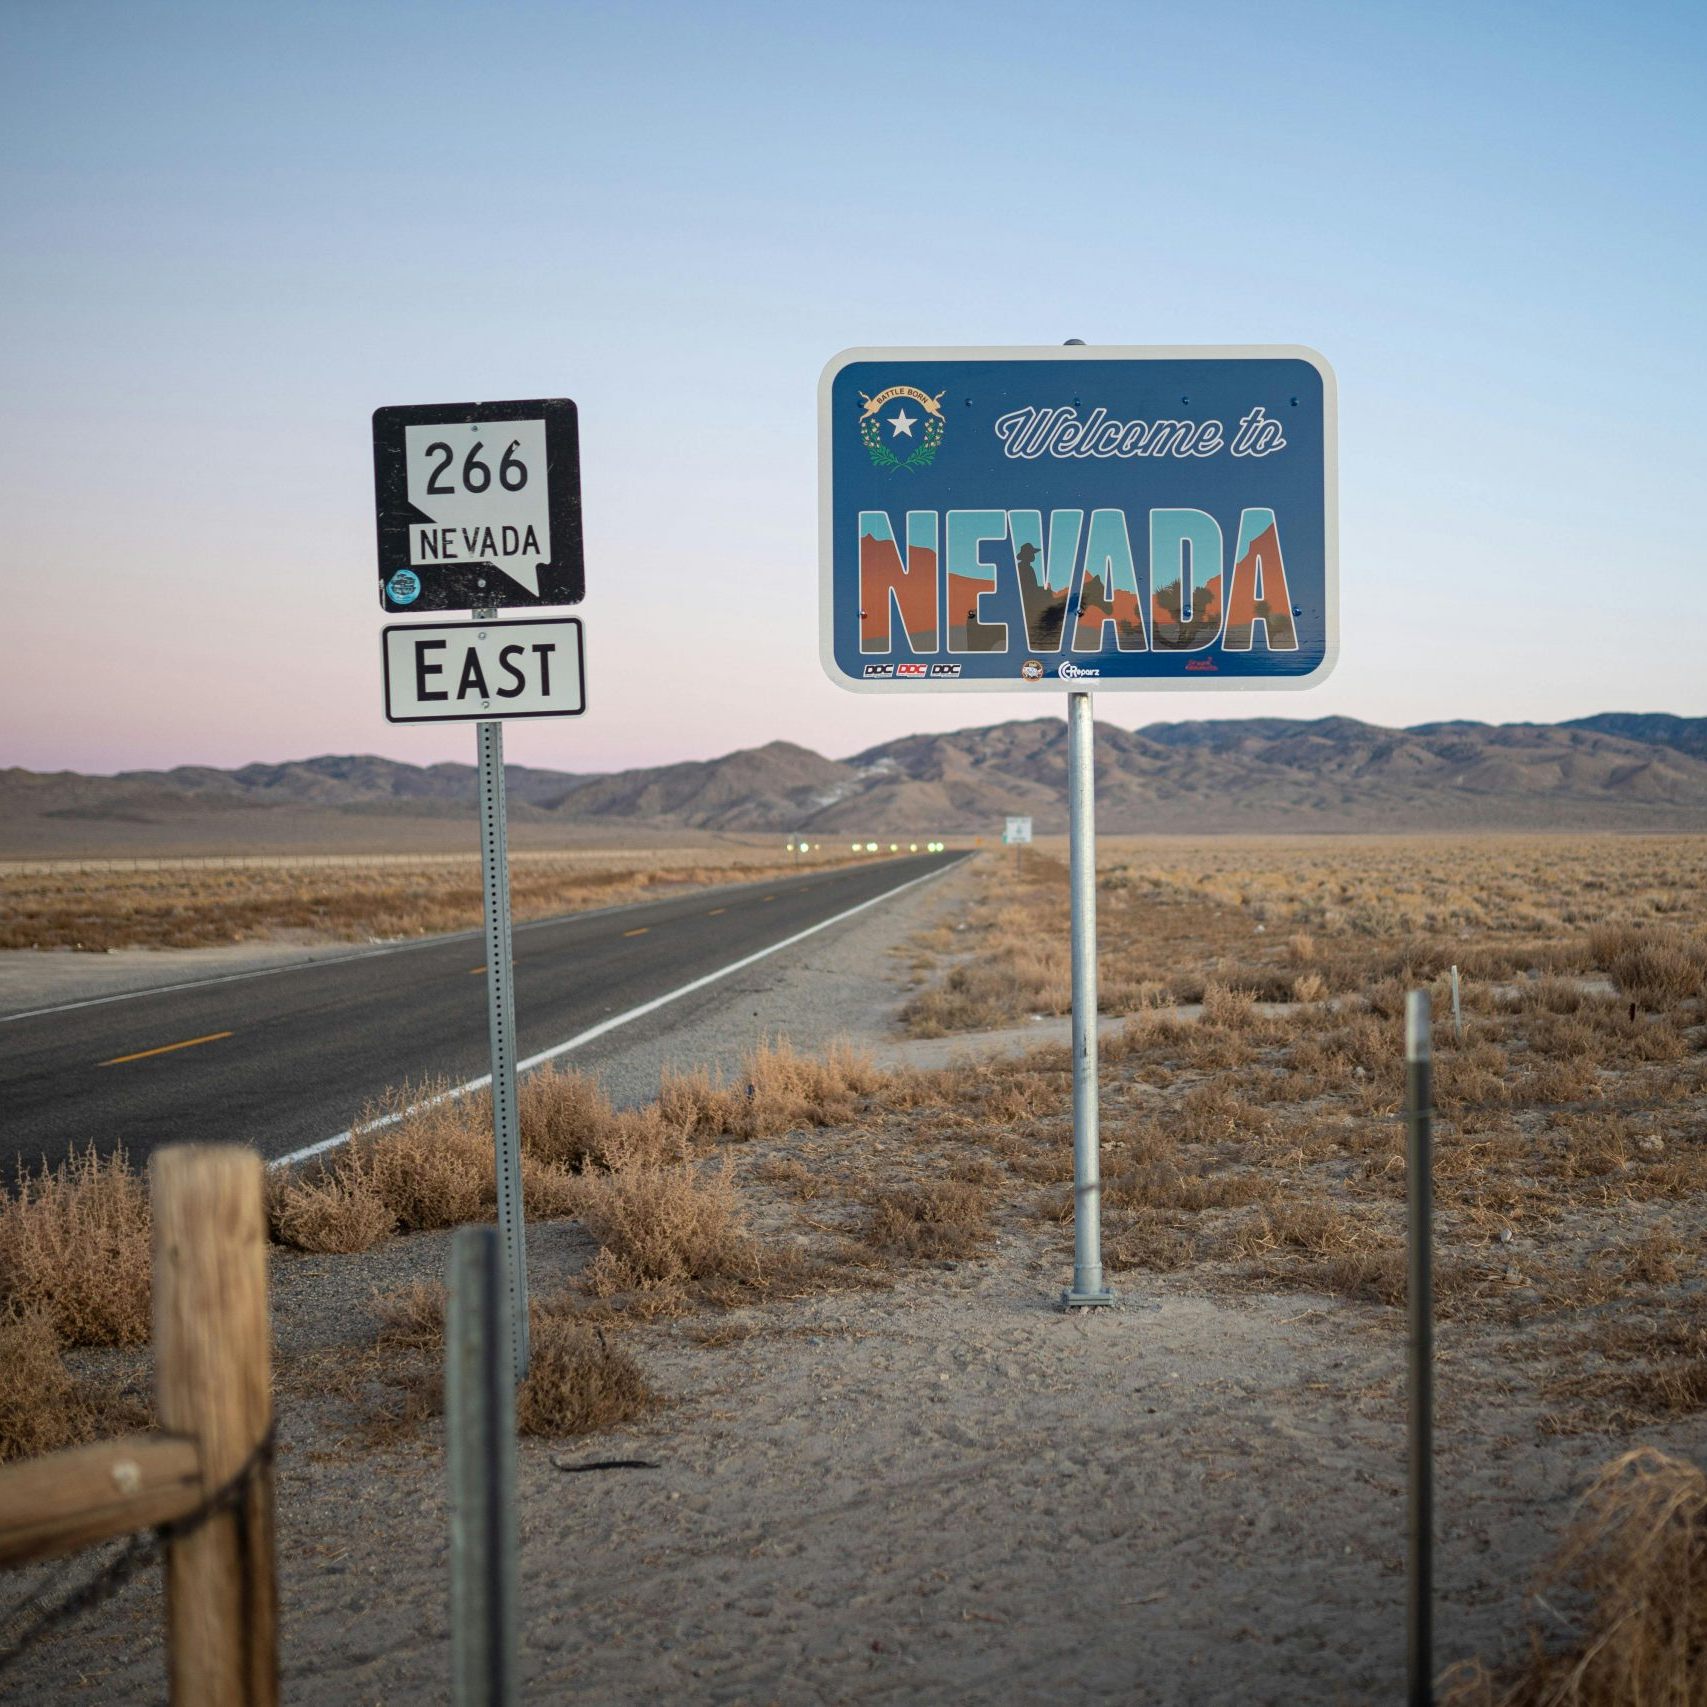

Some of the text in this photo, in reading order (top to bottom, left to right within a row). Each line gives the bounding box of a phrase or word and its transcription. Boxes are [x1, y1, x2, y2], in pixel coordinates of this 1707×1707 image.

[877, 388, 928, 404] BATTLE BORN
[995, 406, 1287, 459] Welcome to
[425, 440, 528, 495] 266
[420, 525, 541, 560] NEVADA
[858, 508, 1299, 654] NEVADA
[415, 639, 556, 702] EAST
